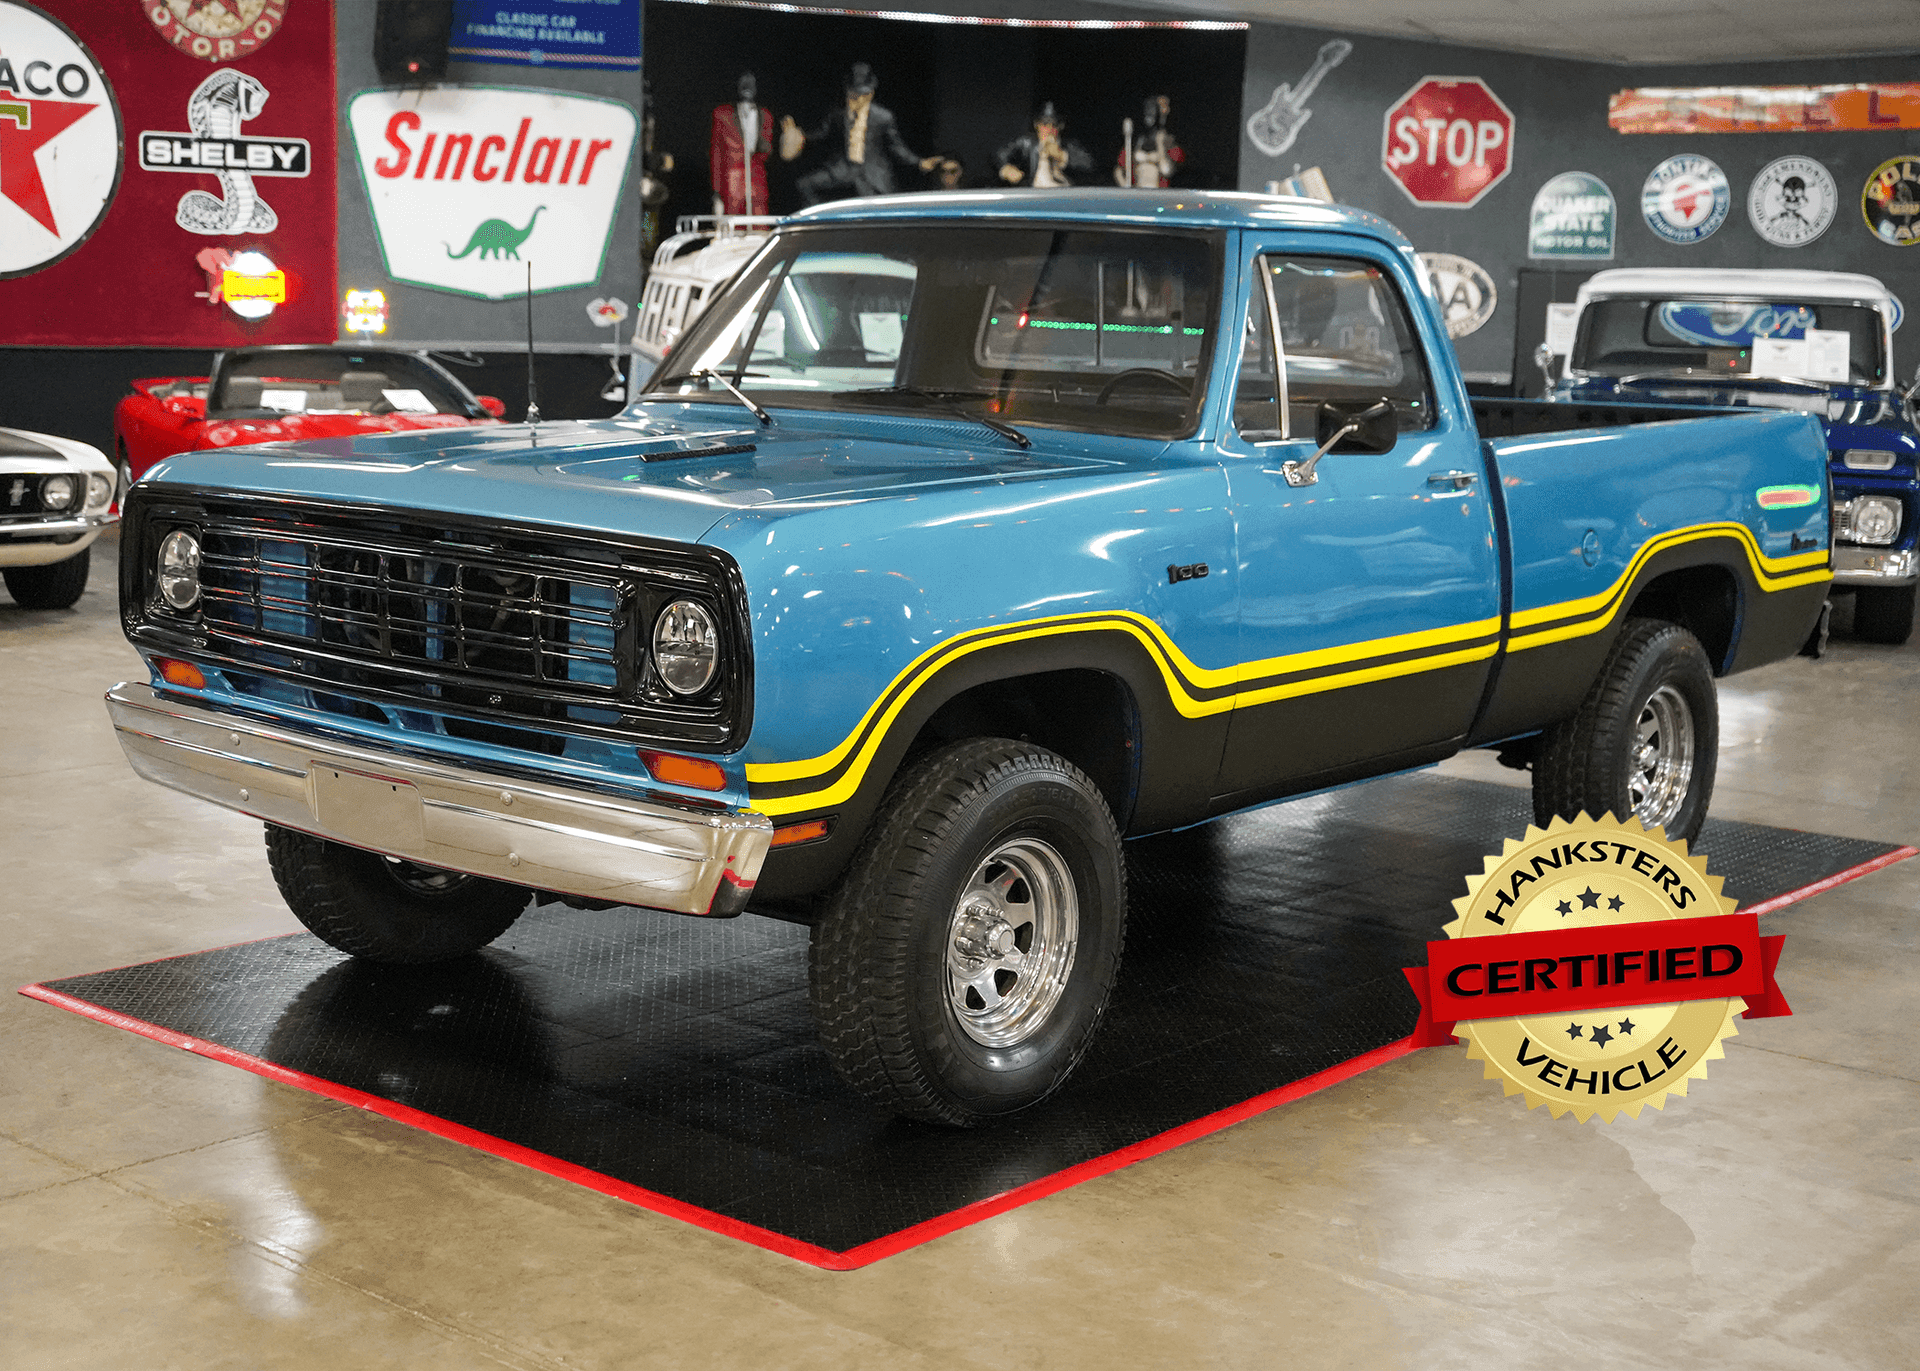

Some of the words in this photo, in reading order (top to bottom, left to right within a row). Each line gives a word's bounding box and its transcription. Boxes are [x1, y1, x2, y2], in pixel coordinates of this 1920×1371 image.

[495, 11, 549, 27] CLASSIC
[550, 14, 577, 28] CAR
[466, 23, 536, 40] FINANCING
[538, 28, 606, 45] AVAILABLE
[374, 111, 613, 185] Sinclair
[1392, 116, 1504, 168] STOP
[147, 140, 301, 169] SHELBY
[1539, 196, 1611, 214] QUAKER
[1545, 214, 1605, 232] STATE
[1535, 235, 1583, 249] MOTOR
[1587, 236, 1610, 249] OIL
